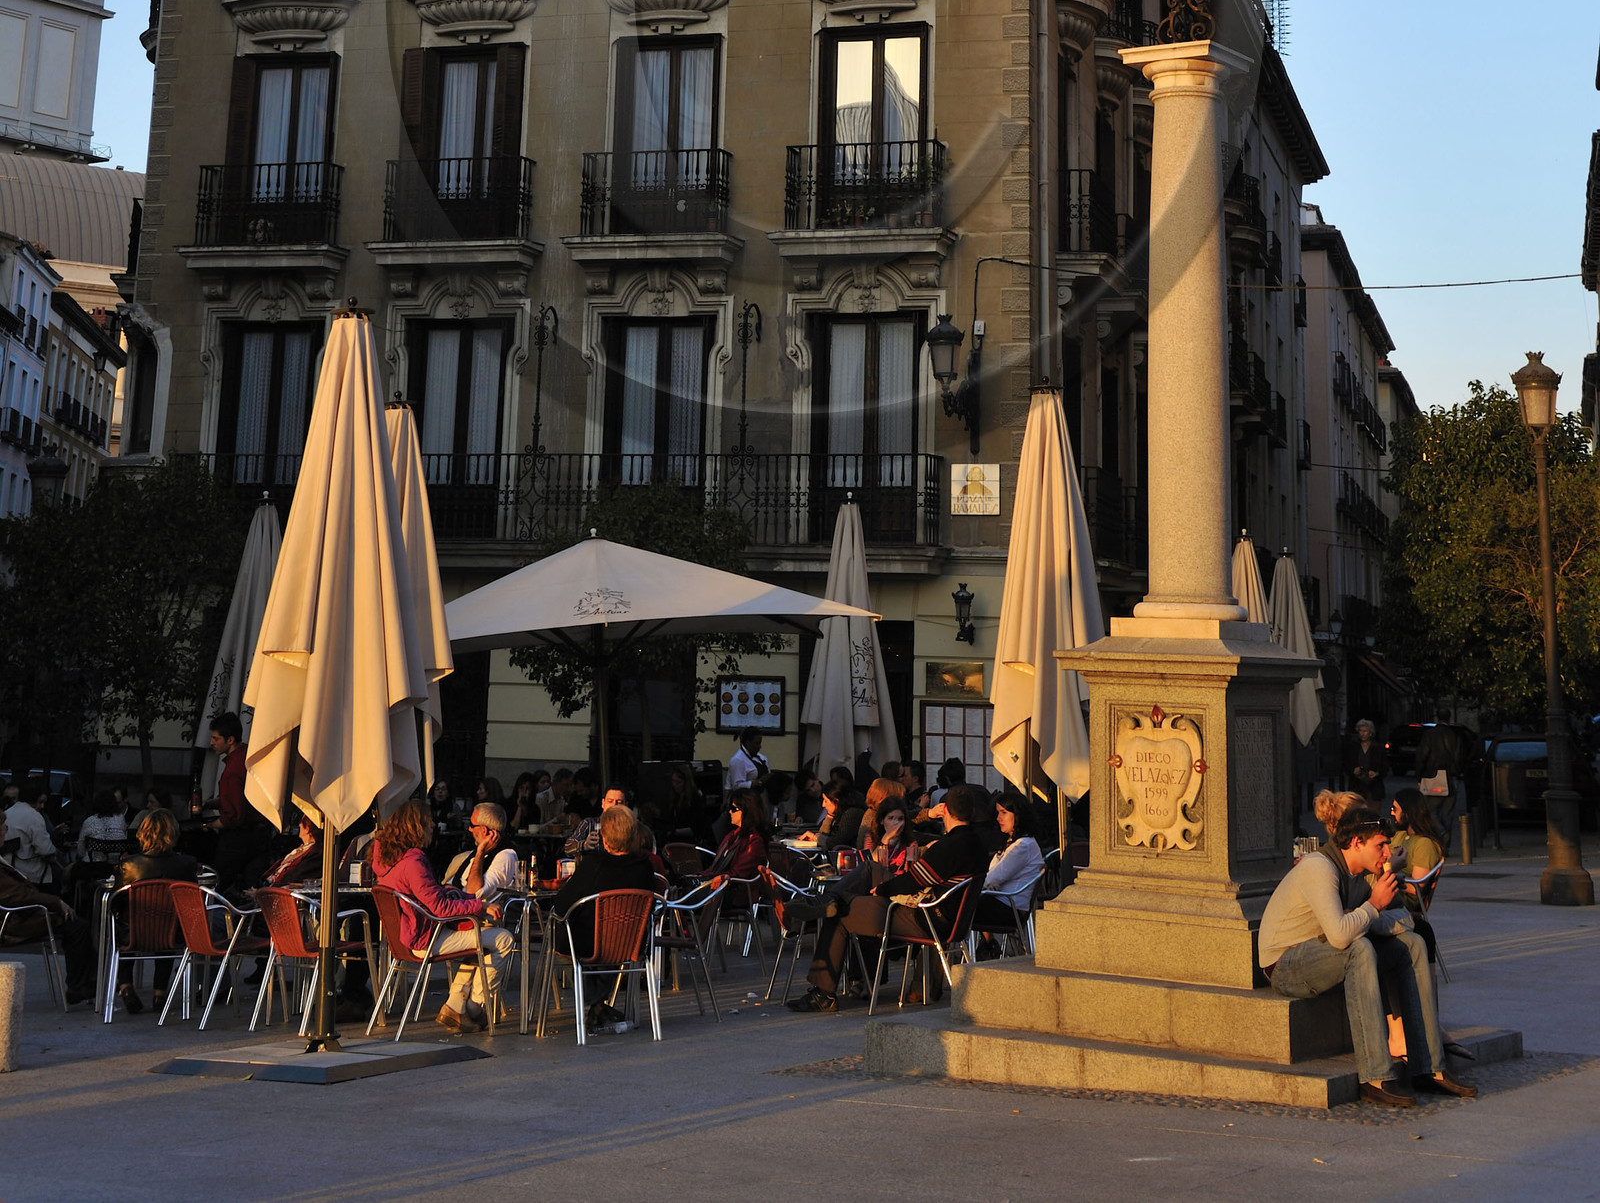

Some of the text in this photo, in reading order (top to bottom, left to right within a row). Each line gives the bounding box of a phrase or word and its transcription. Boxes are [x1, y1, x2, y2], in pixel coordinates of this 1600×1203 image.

[956, 494, 984, 503] PLAZA
[953, 503, 998, 514] RAMALES
[1145, 787, 1169, 799] 1599
[1145, 803, 1169, 817] 1660
